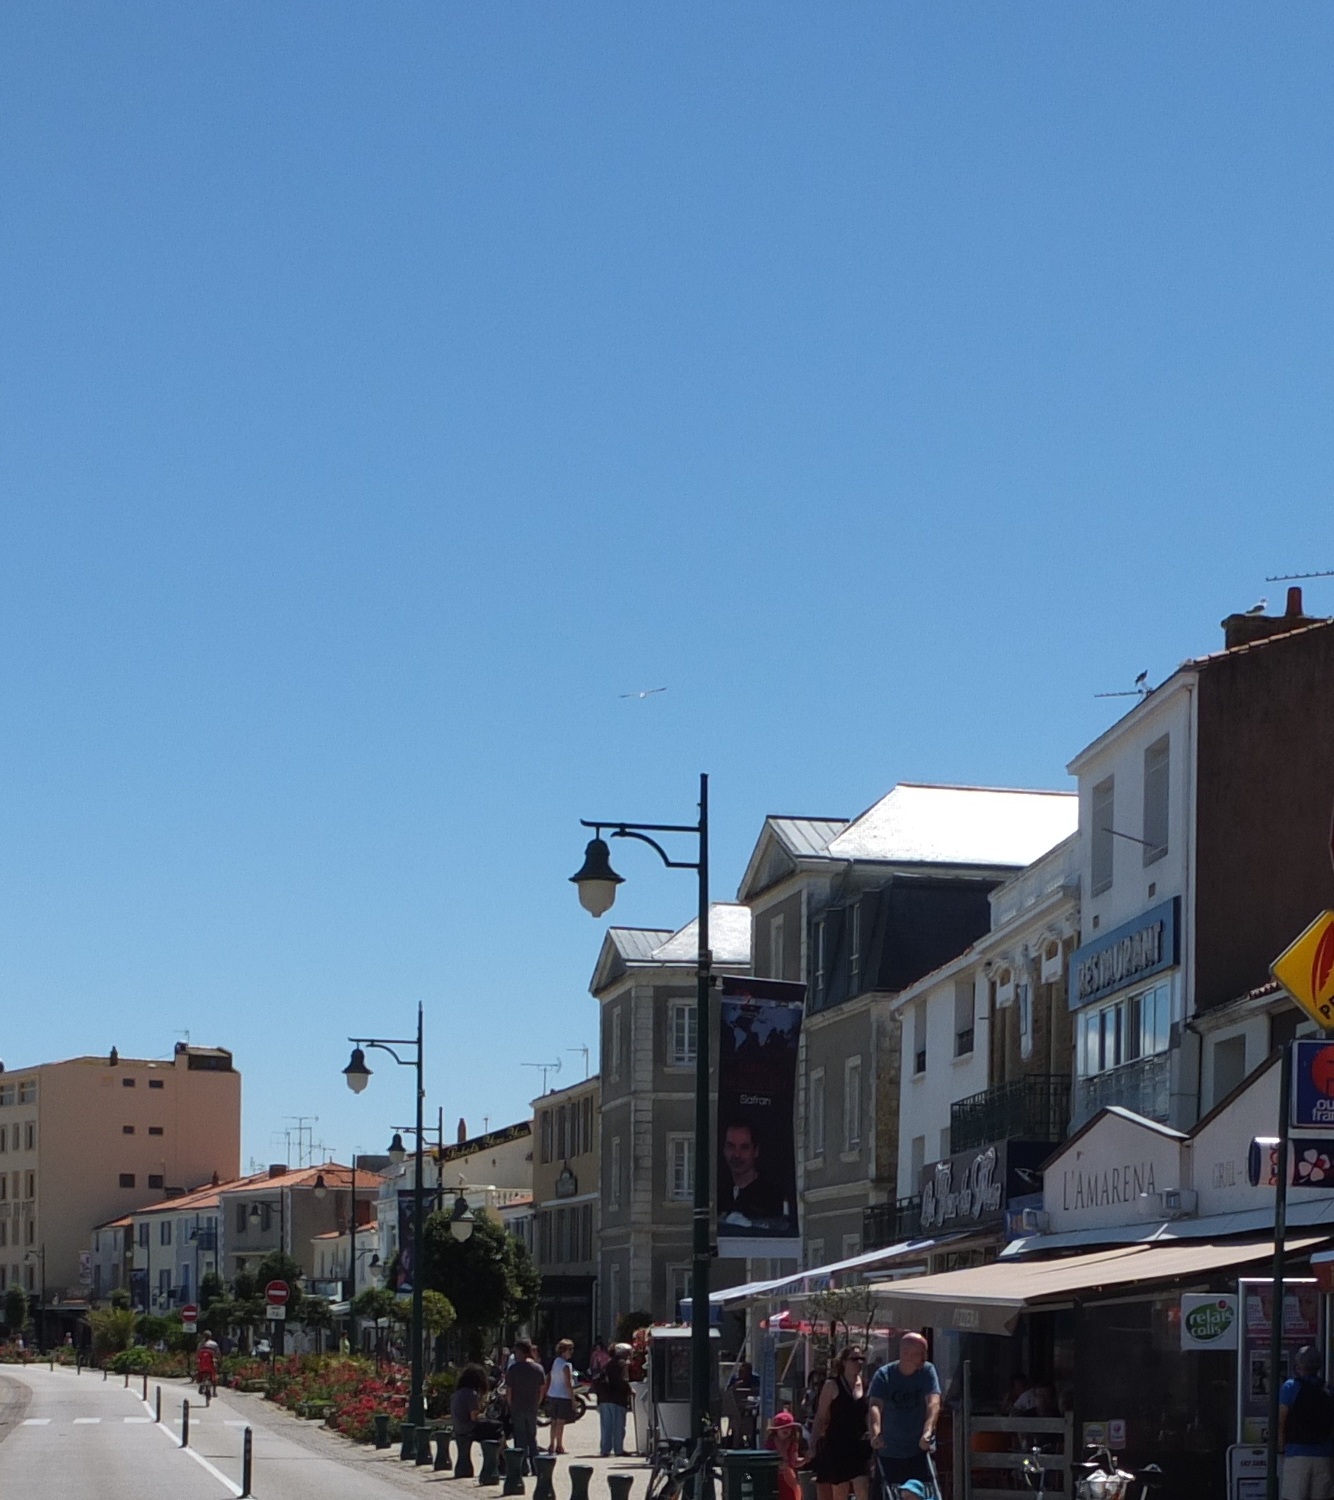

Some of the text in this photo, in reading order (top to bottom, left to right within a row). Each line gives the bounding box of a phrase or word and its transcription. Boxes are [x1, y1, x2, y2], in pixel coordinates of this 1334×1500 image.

[1078, 919, 1164, 1001] RESTAURANT
[739, 1093, 772, 1106] Safran
[1062, 1161, 1156, 1212] L'AMARENA
[1189, 1307, 1234, 1326] relais
[1190, 1321, 1222, 1336] colis
